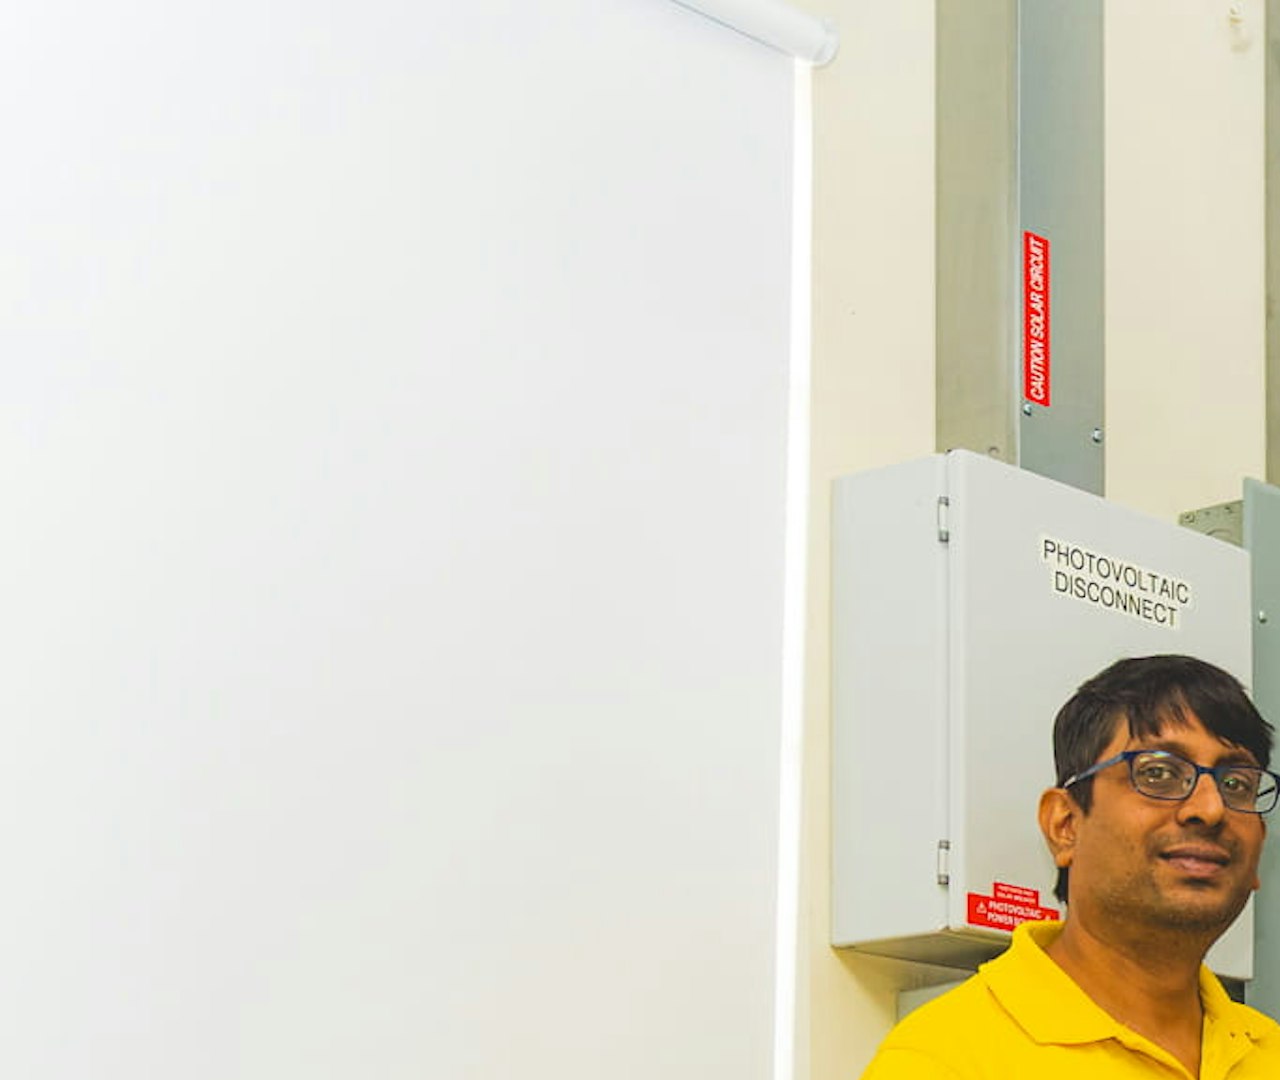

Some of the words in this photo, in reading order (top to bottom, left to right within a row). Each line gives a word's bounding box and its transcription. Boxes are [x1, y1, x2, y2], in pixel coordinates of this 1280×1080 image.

[1030, 236, 1045, 290] CIRCUIT
[1030, 291, 1046, 339] SOLAR
[1030, 339, 1046, 400] CAUTION
[1043, 539, 1189, 605] PHOTOVOLTAIC
[1055, 571, 1178, 626] DISCONNECT
